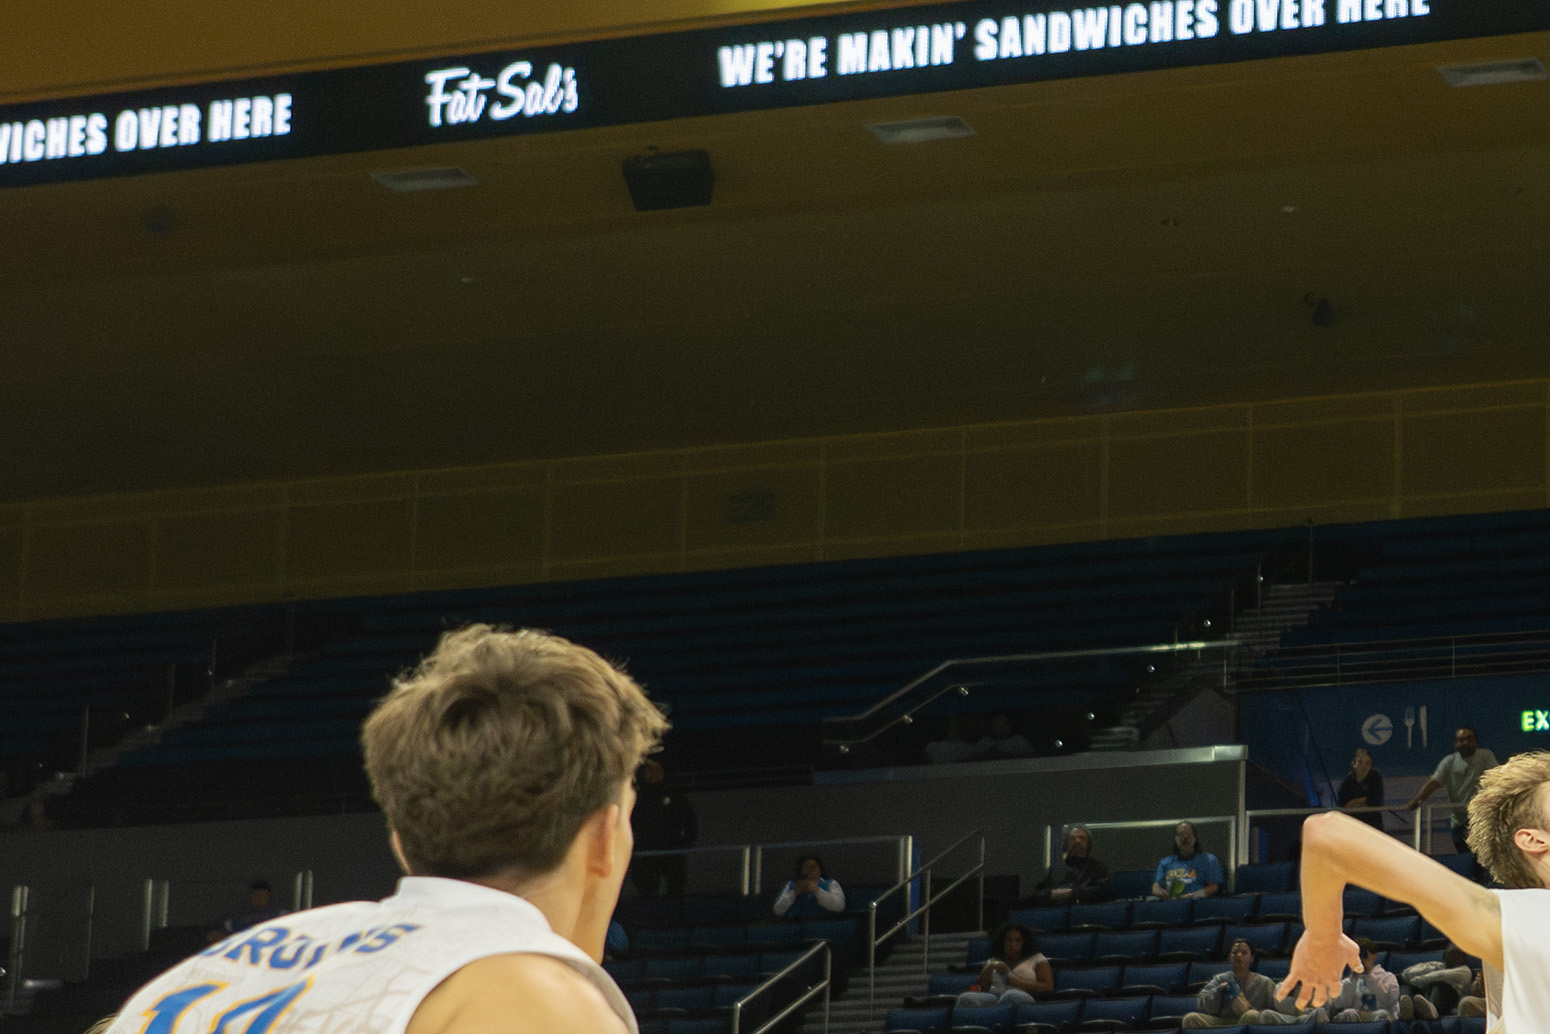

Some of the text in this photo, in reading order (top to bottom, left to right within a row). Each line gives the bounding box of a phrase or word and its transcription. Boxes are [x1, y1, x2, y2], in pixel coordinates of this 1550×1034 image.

[718, 36, 828, 87] WE'RE
[837, 22, 966, 75] MAKIN'
[974, 1, 1219, 62] SANDWICHES
[1228, 0, 1326, 35] OVER
[114, 103, 201, 152] OVER
[208, 93, 292, 142] HERE
[425, 61, 578, 127] Fat Sal's
